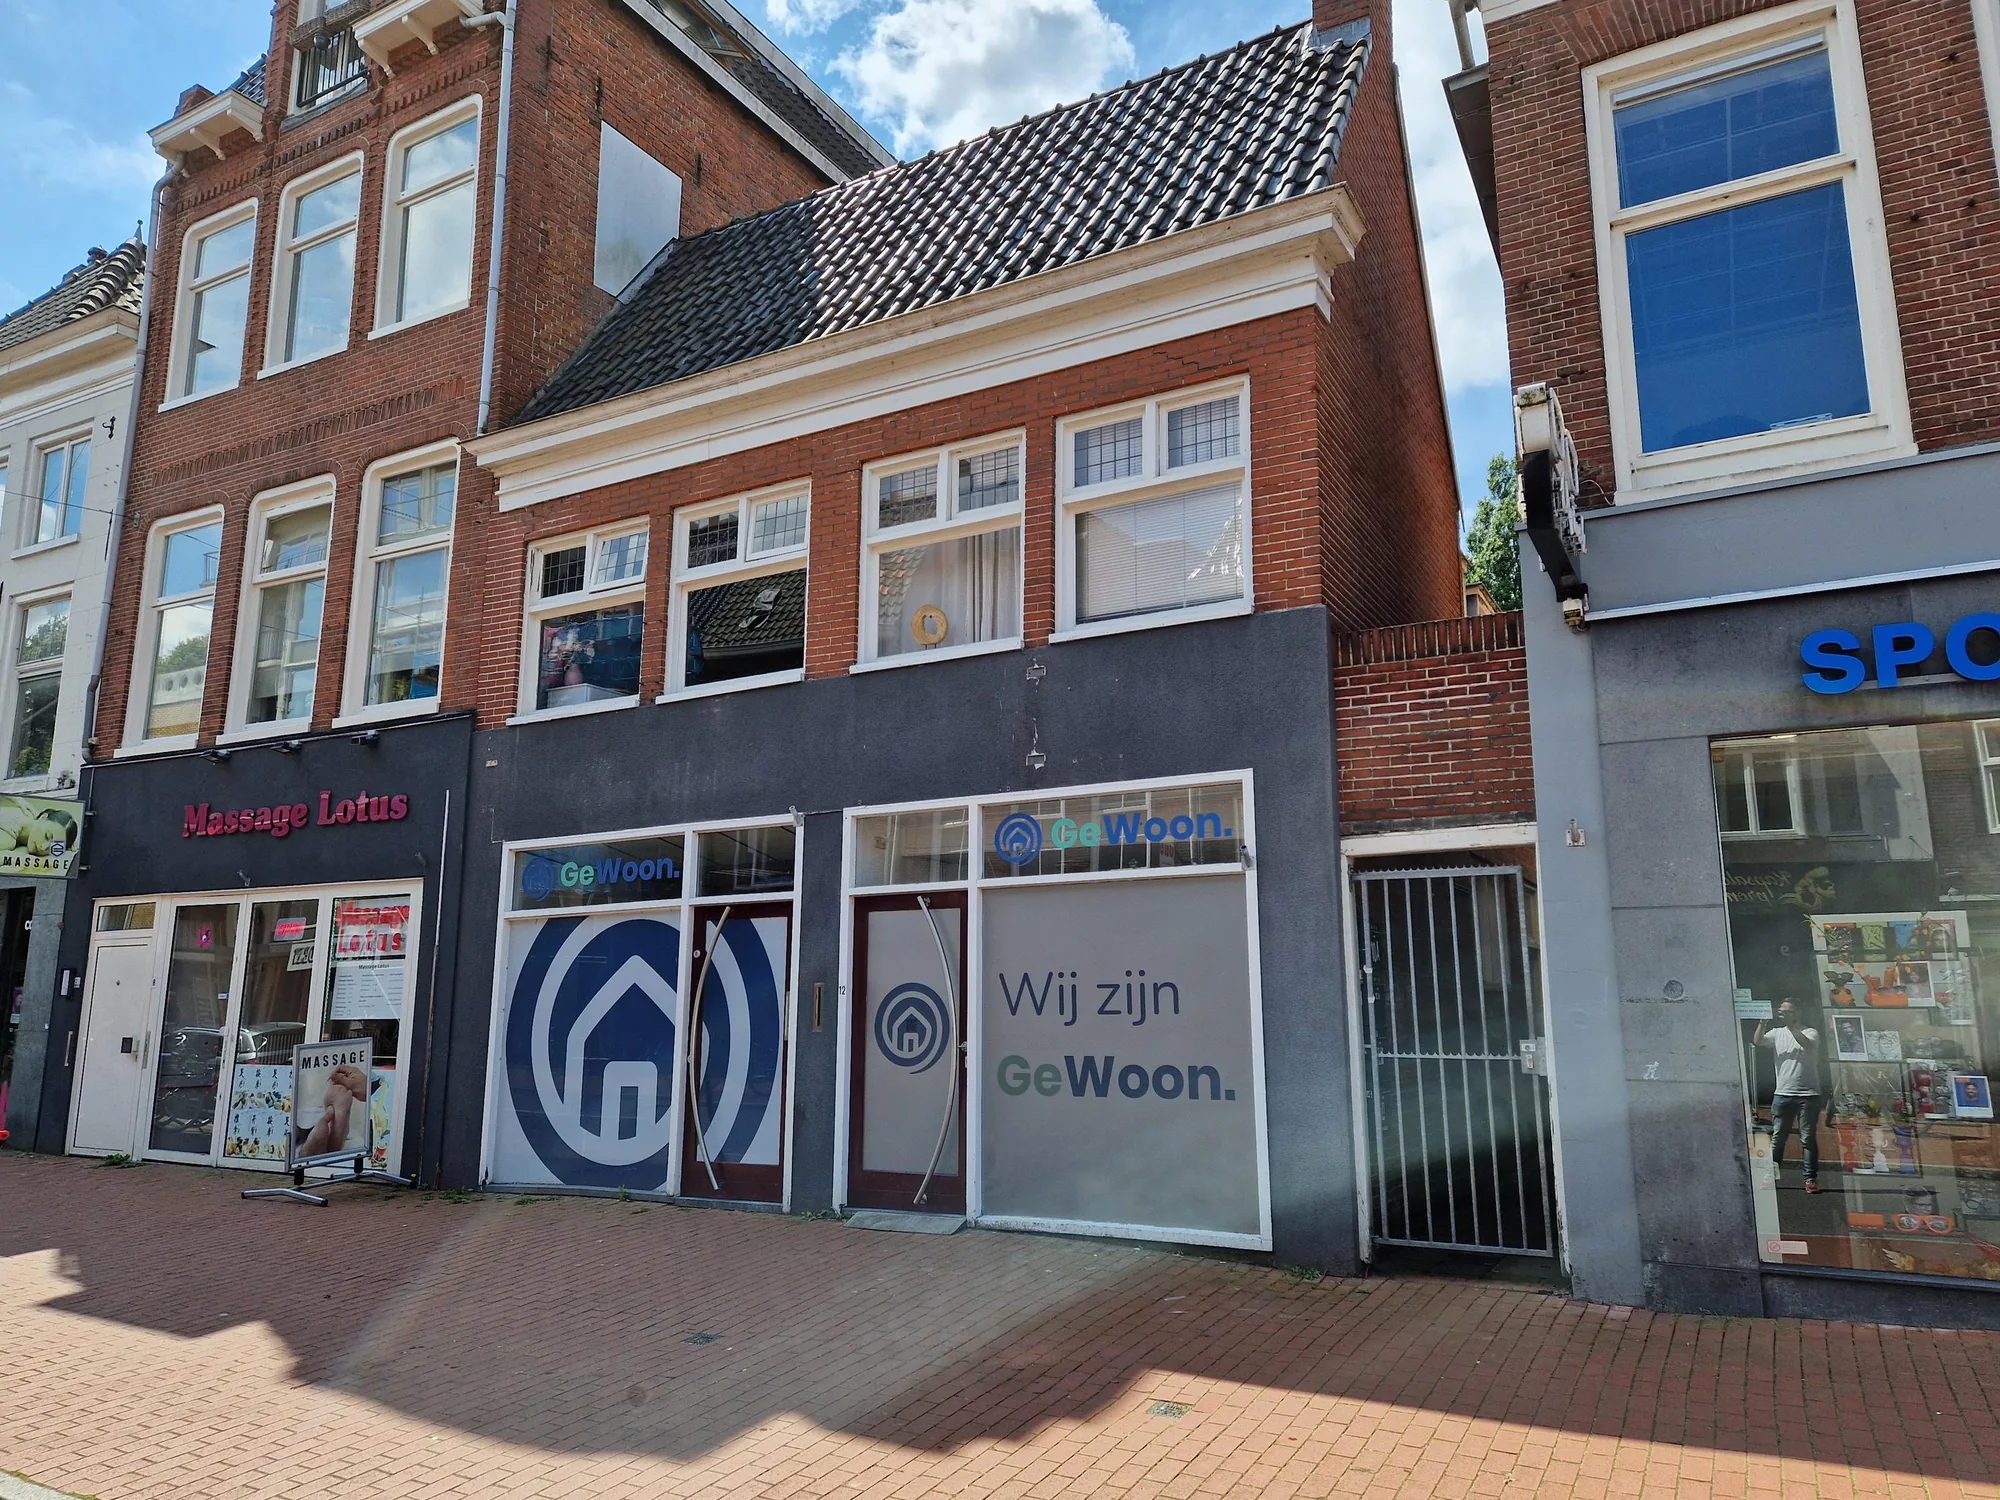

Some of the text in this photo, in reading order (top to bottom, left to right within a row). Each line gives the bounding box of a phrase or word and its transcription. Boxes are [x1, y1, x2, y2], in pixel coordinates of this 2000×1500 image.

[181, 789, 408, 838] Massage Lotus
[1051, 811, 1233, 850] GeWoon.
[3, 856, 69, 870] MASSAGE
[560, 856, 680, 887] GeWoon.
[337, 929, 402, 953] Lotus
[838, 985, 846, 996] 12
[998, 969, 1180, 1027] Wij zijn
[301, 1050, 365, 1070] MASSAGE
[996, 1055, 1236, 1101] GeWoon.
